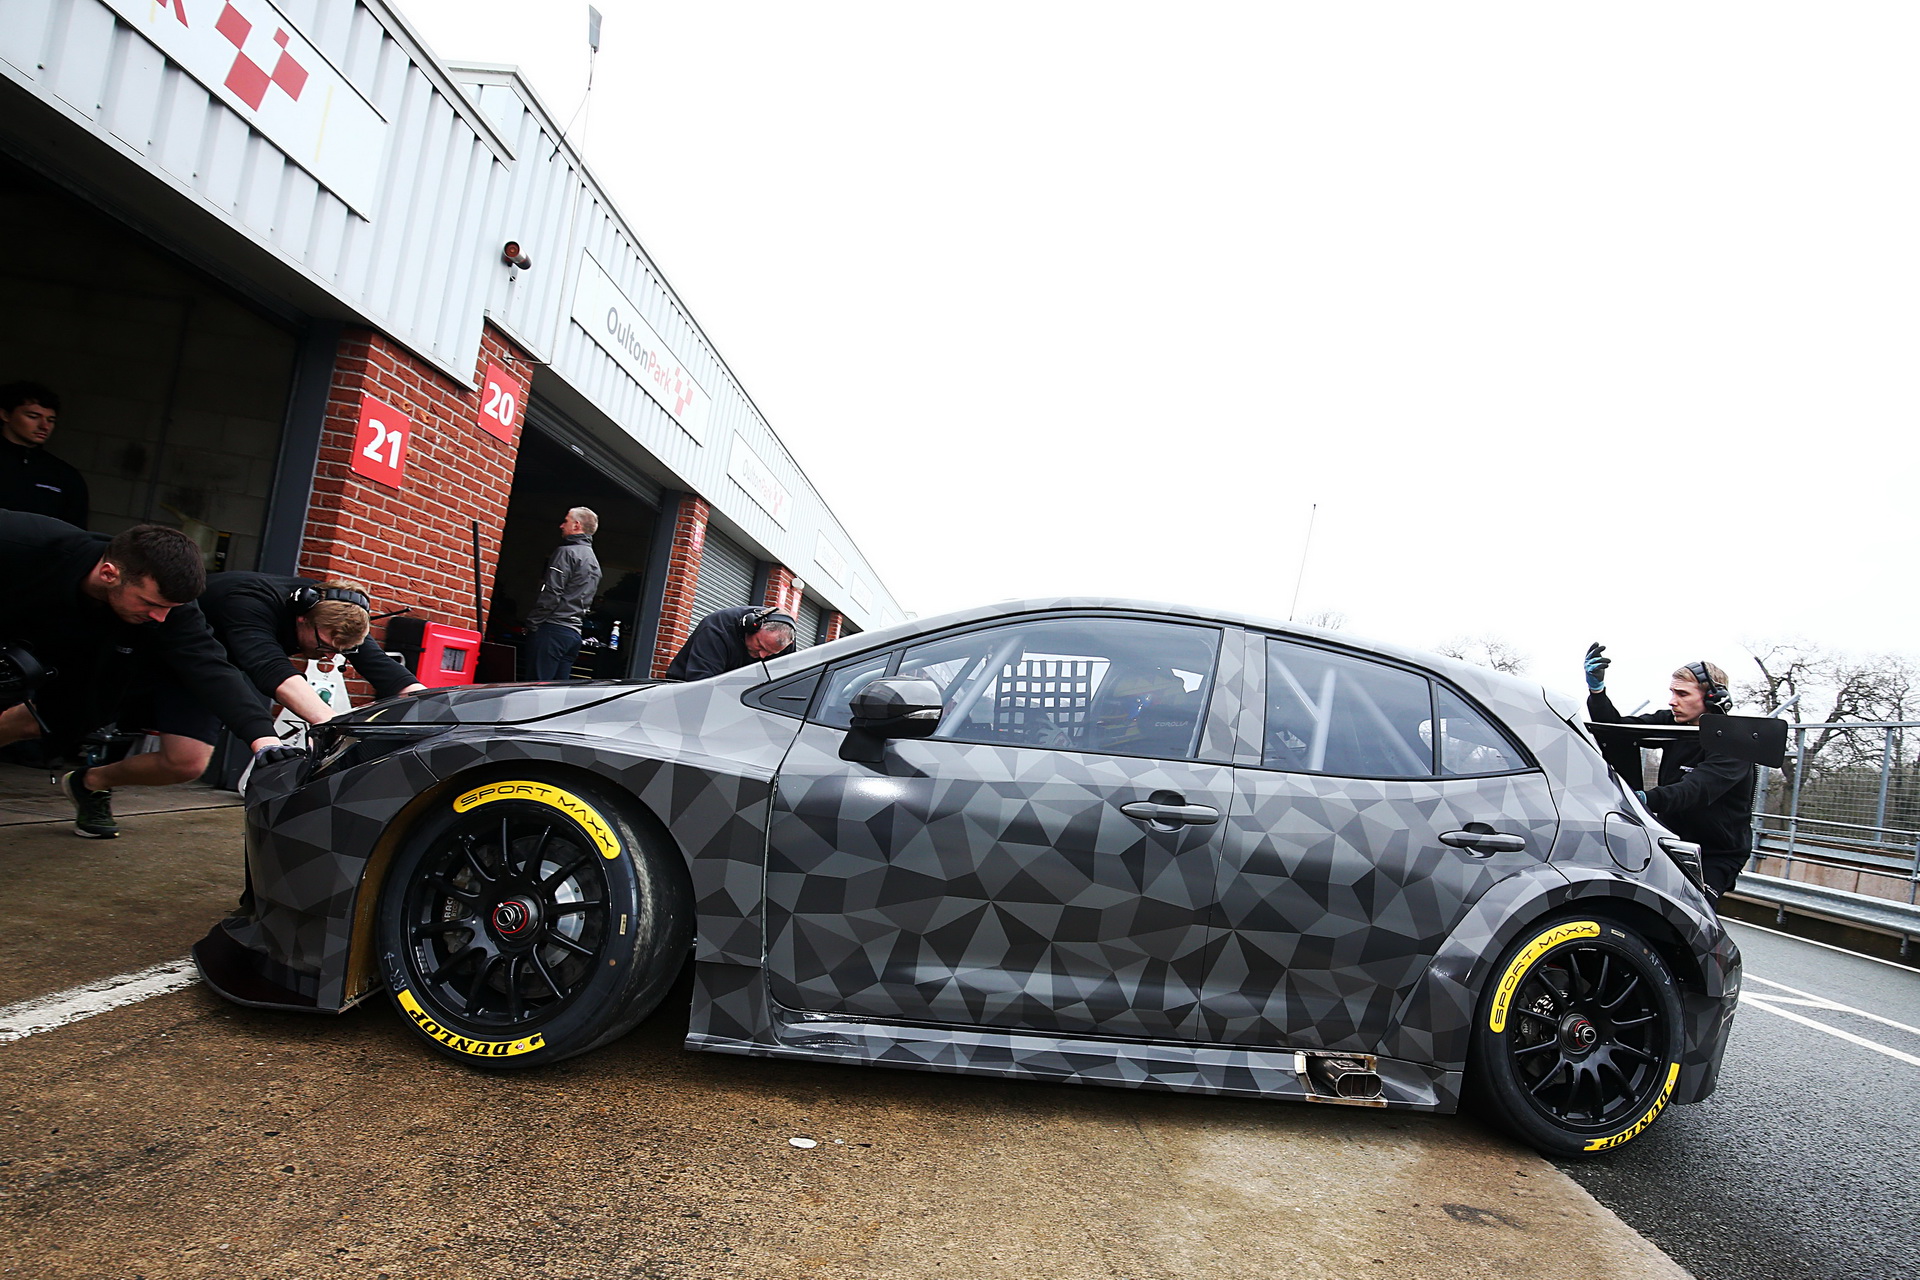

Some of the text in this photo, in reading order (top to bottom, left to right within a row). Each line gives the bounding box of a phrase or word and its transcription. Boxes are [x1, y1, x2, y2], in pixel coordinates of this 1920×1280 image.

[606, 306, 672, 395] OultonPark
[483, 381, 515, 427] 20
[362, 418, 403, 470] 21
[460, 785, 615, 851] SPORT MAXX
[1494, 925, 1594, 1025] SPORT MAXX
[407, 1008, 513, 1057] DUNLOP
[1598, 1087, 1671, 1150] DUNLOP
